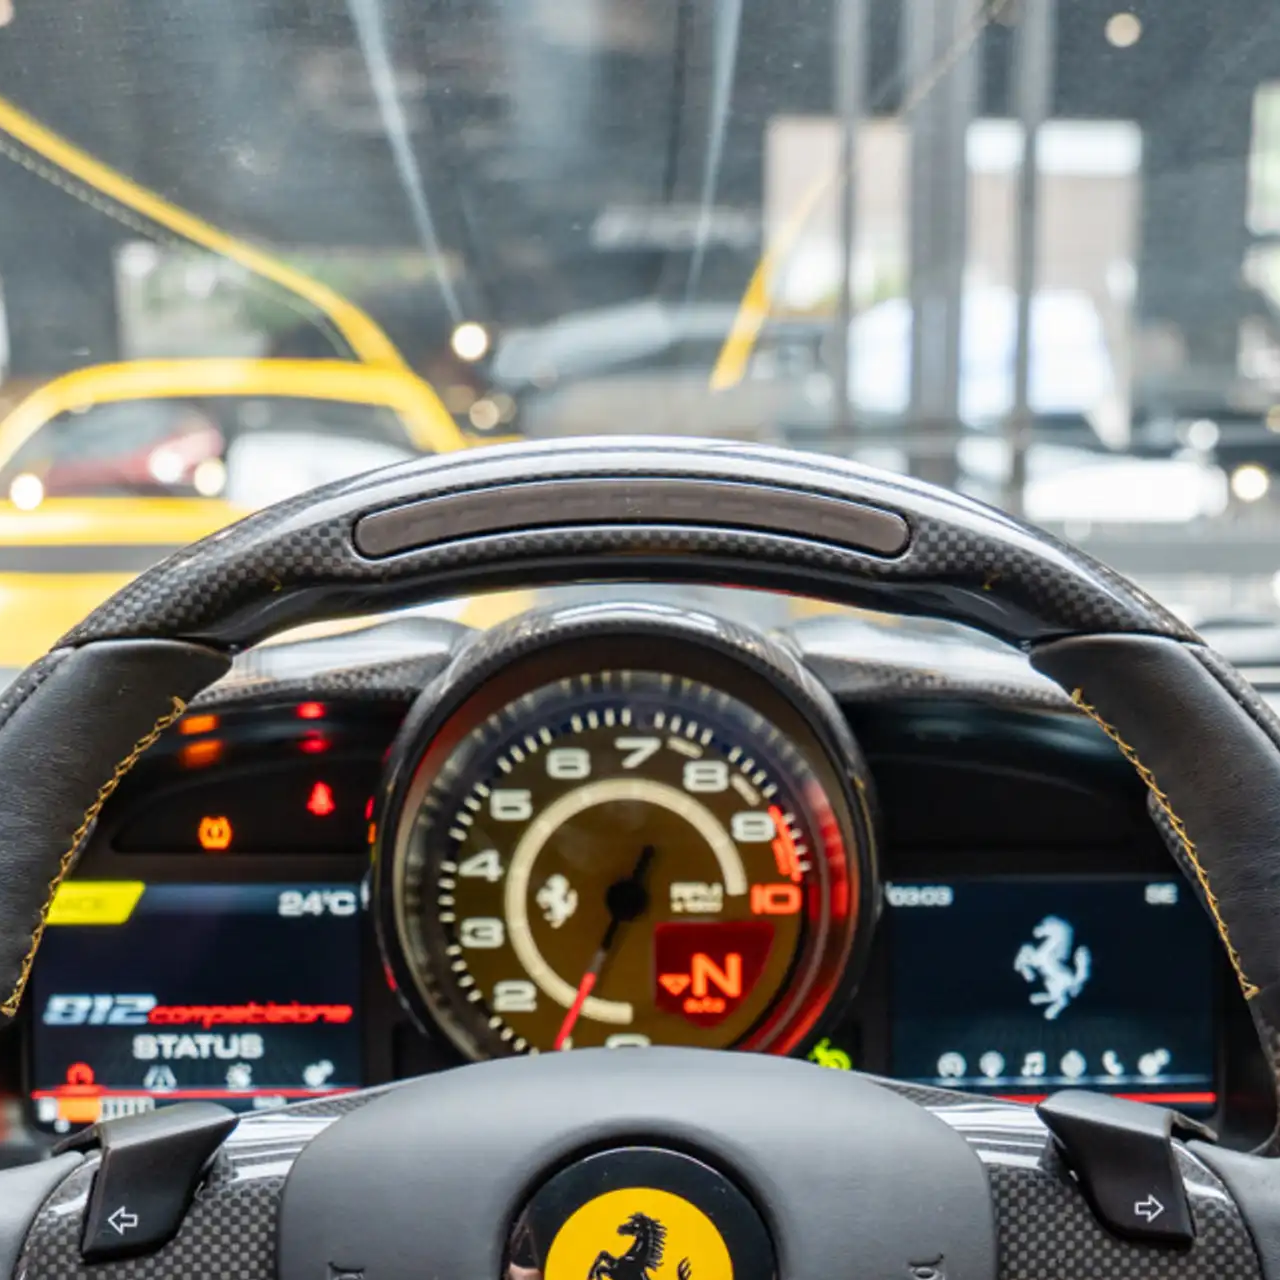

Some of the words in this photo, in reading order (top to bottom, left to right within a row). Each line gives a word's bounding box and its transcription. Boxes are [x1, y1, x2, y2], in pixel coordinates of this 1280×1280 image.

[615, 737, 662, 768] 7
[683, 760, 729, 792] 8
[459, 848, 503, 882] 4
[751, 884, 802, 915] 10
[691, 952, 742, 998] N
[493, 980, 537, 1013] 2
[133, 1033, 264, 1060] STATUS
